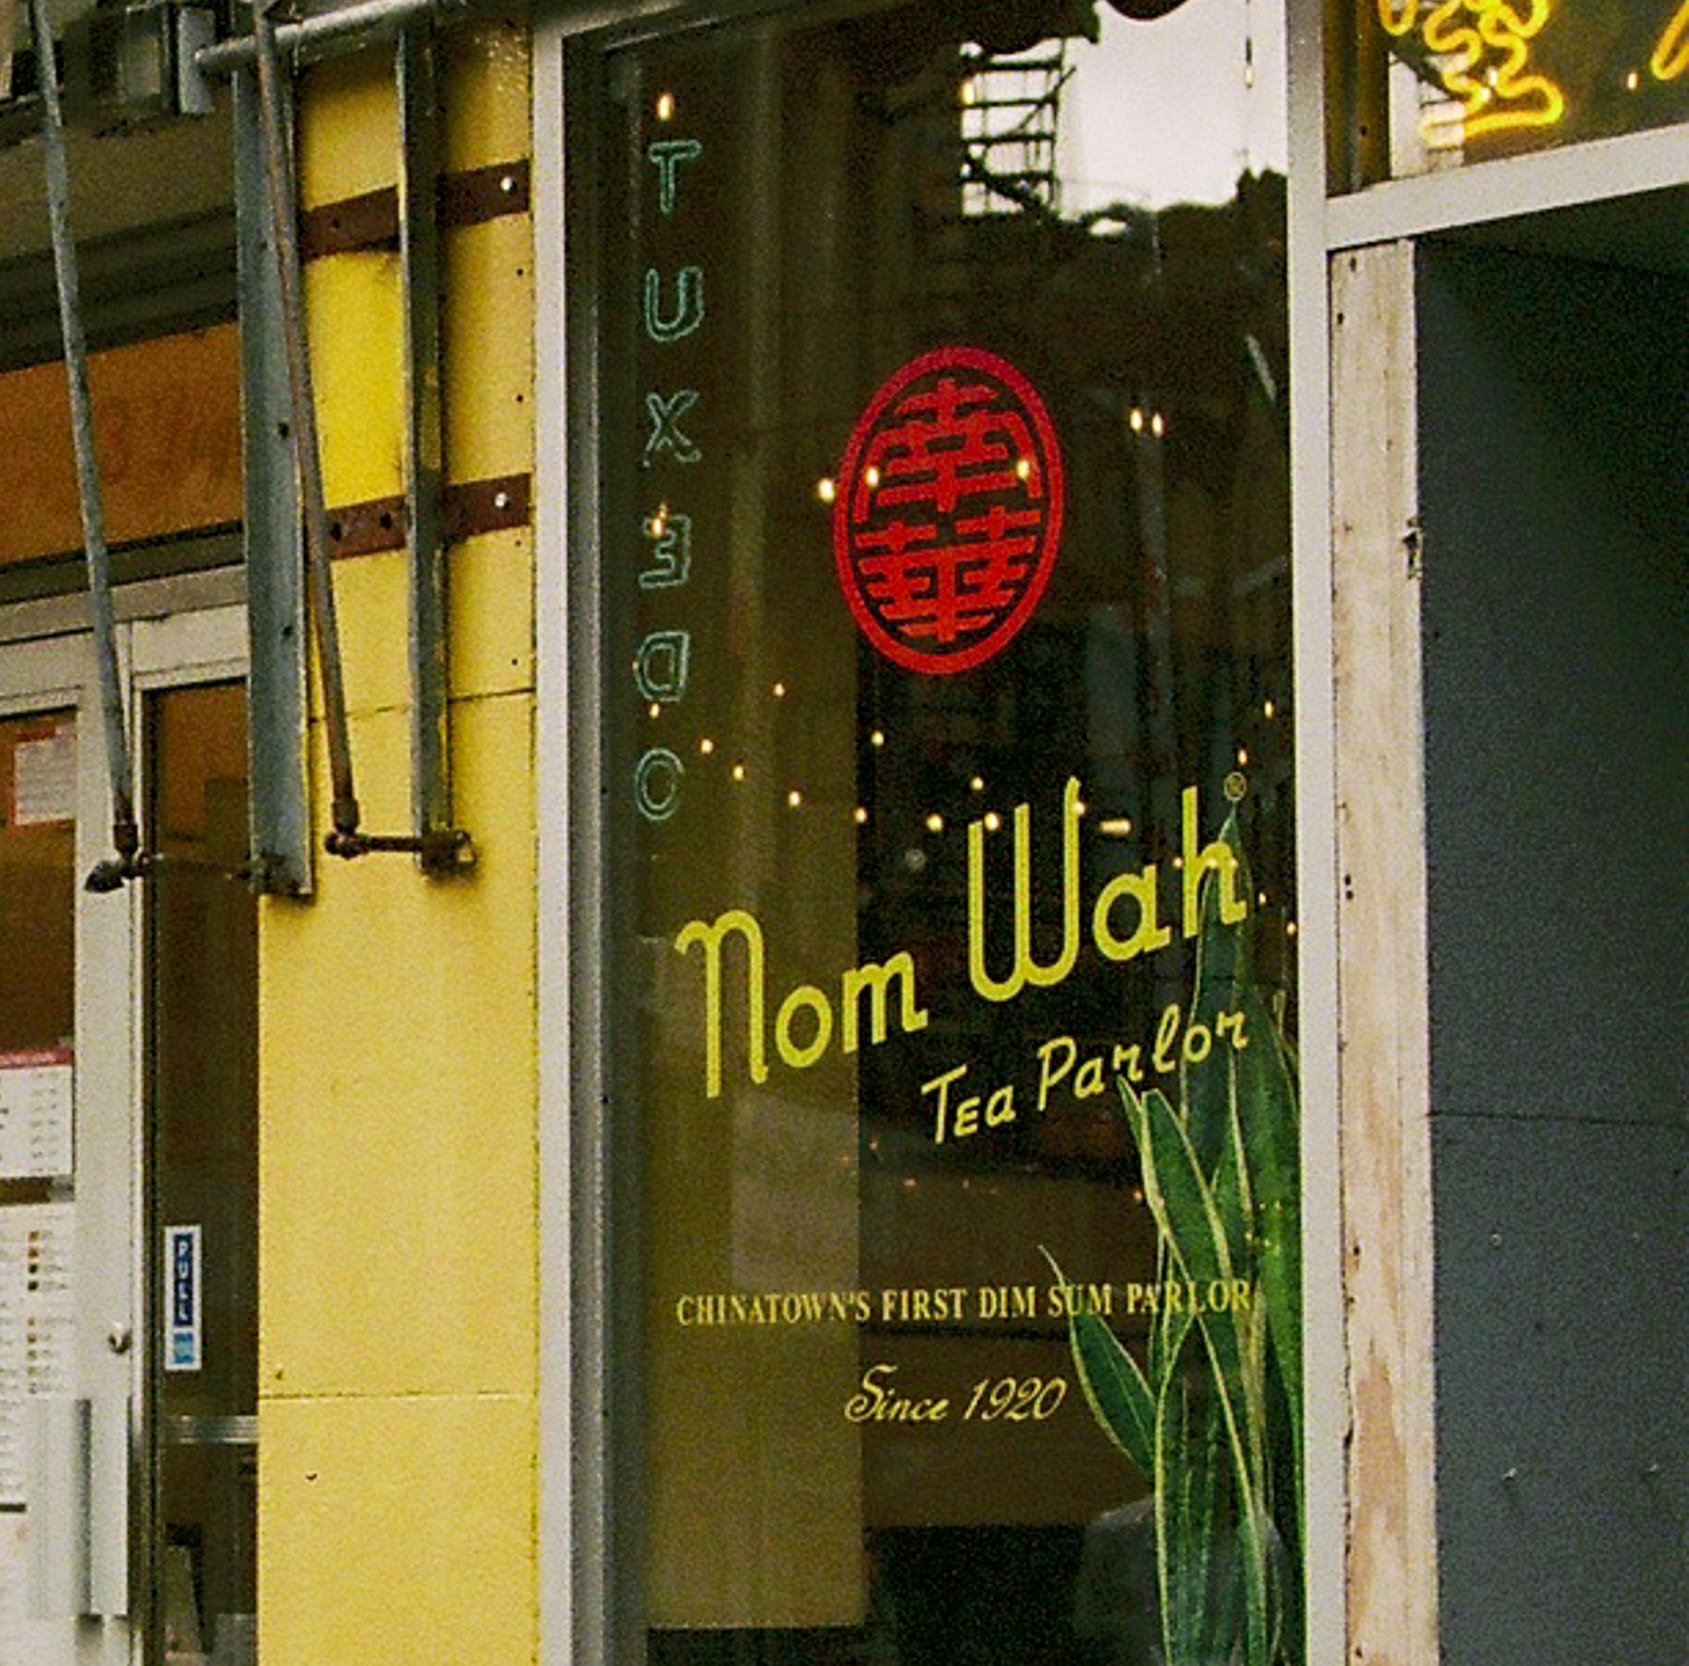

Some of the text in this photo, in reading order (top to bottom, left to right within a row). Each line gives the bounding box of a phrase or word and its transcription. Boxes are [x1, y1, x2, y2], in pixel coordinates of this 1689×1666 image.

[675, 777, 1248, 1099] Nom Wah
[921, 1003, 1248, 1145] Tea Parlor
[177, 1239, 190, 1322] PULL
[676, 1279, 1254, 1326] CHINATOWN'S FIRST DIM SUM PARLOR
[843, 1363, 1069, 1423] Since 1920
